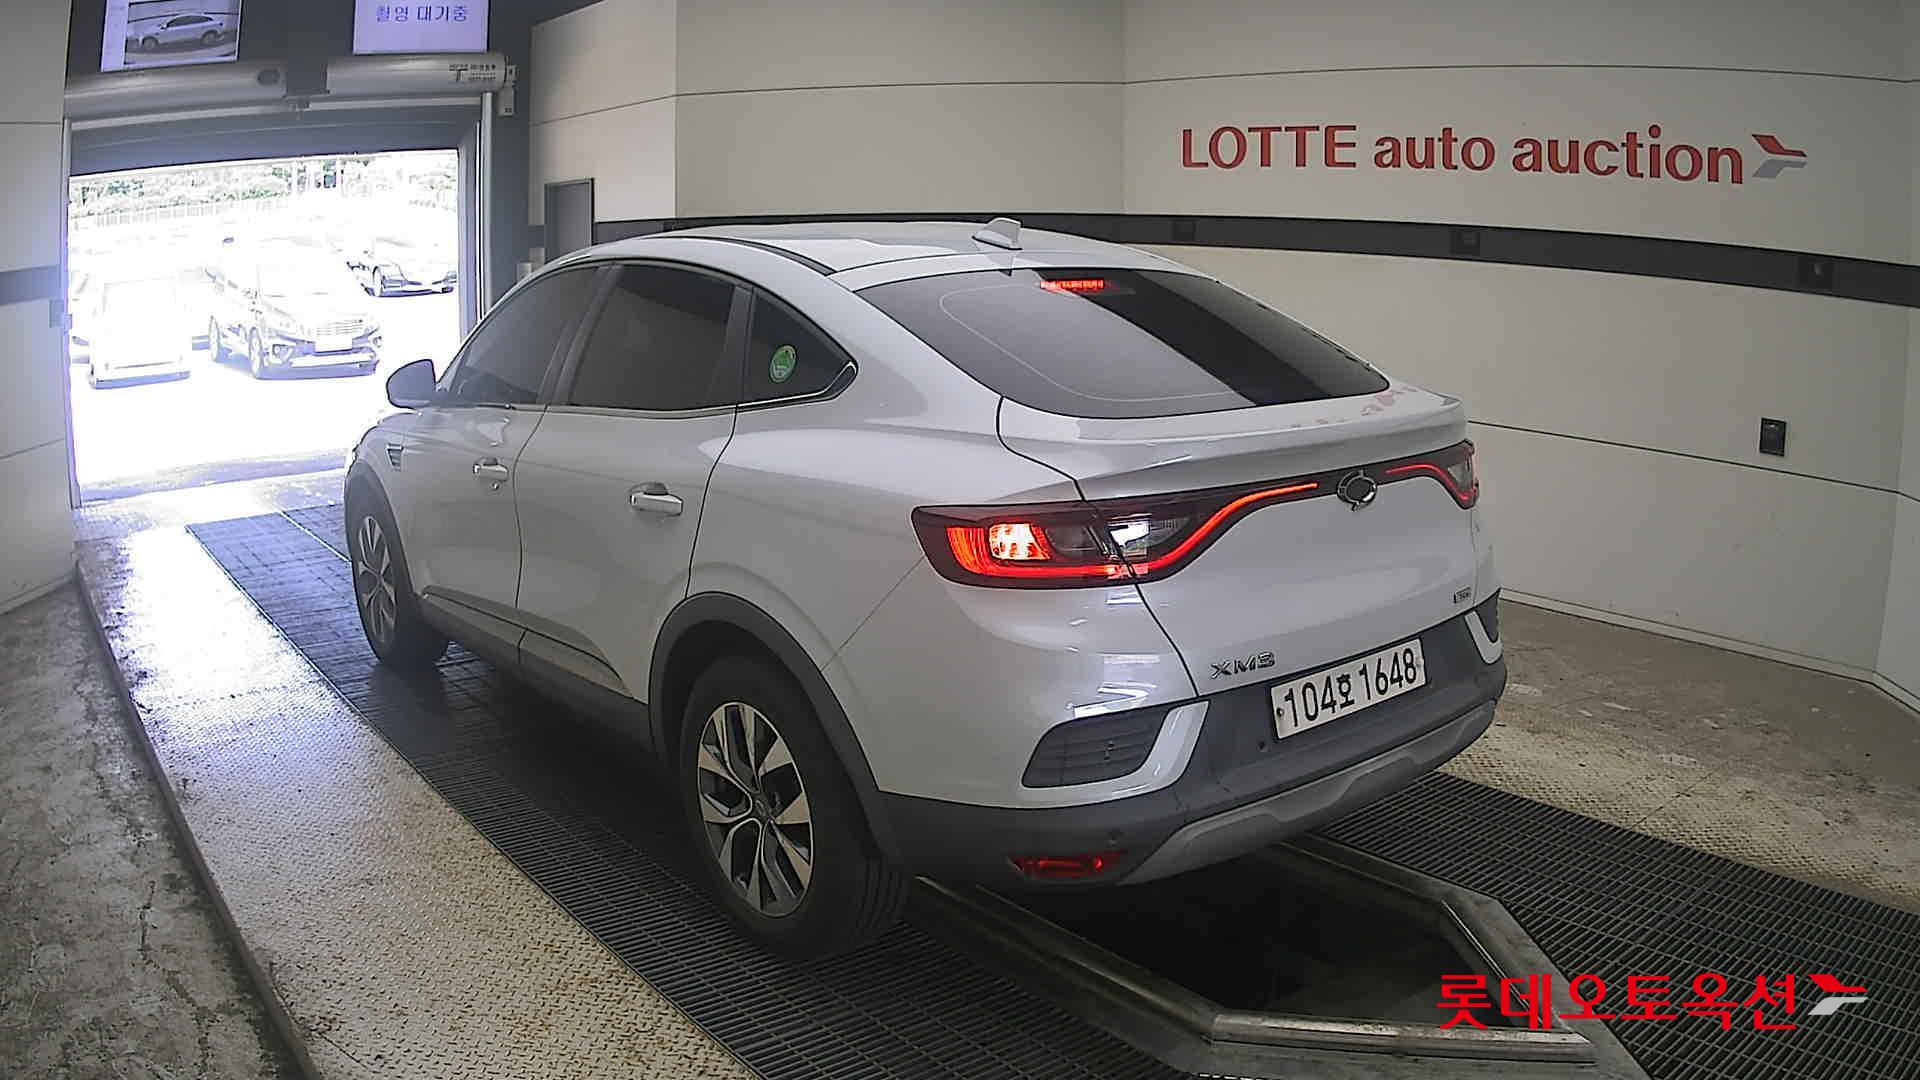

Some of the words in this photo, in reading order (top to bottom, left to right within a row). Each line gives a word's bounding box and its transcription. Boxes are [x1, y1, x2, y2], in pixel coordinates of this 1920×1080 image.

[417, 6, 466, 21] 대기중
[1182, 125, 1357, 169] LOTTE
[1373, 127, 1496, 171] auto
[1511, 124, 1744, 184] auction
[1210, 651, 1276, 679] XM3
[1283, 673, 1355, 728] 104호
[1358, 647, 1417, 701] 1648
